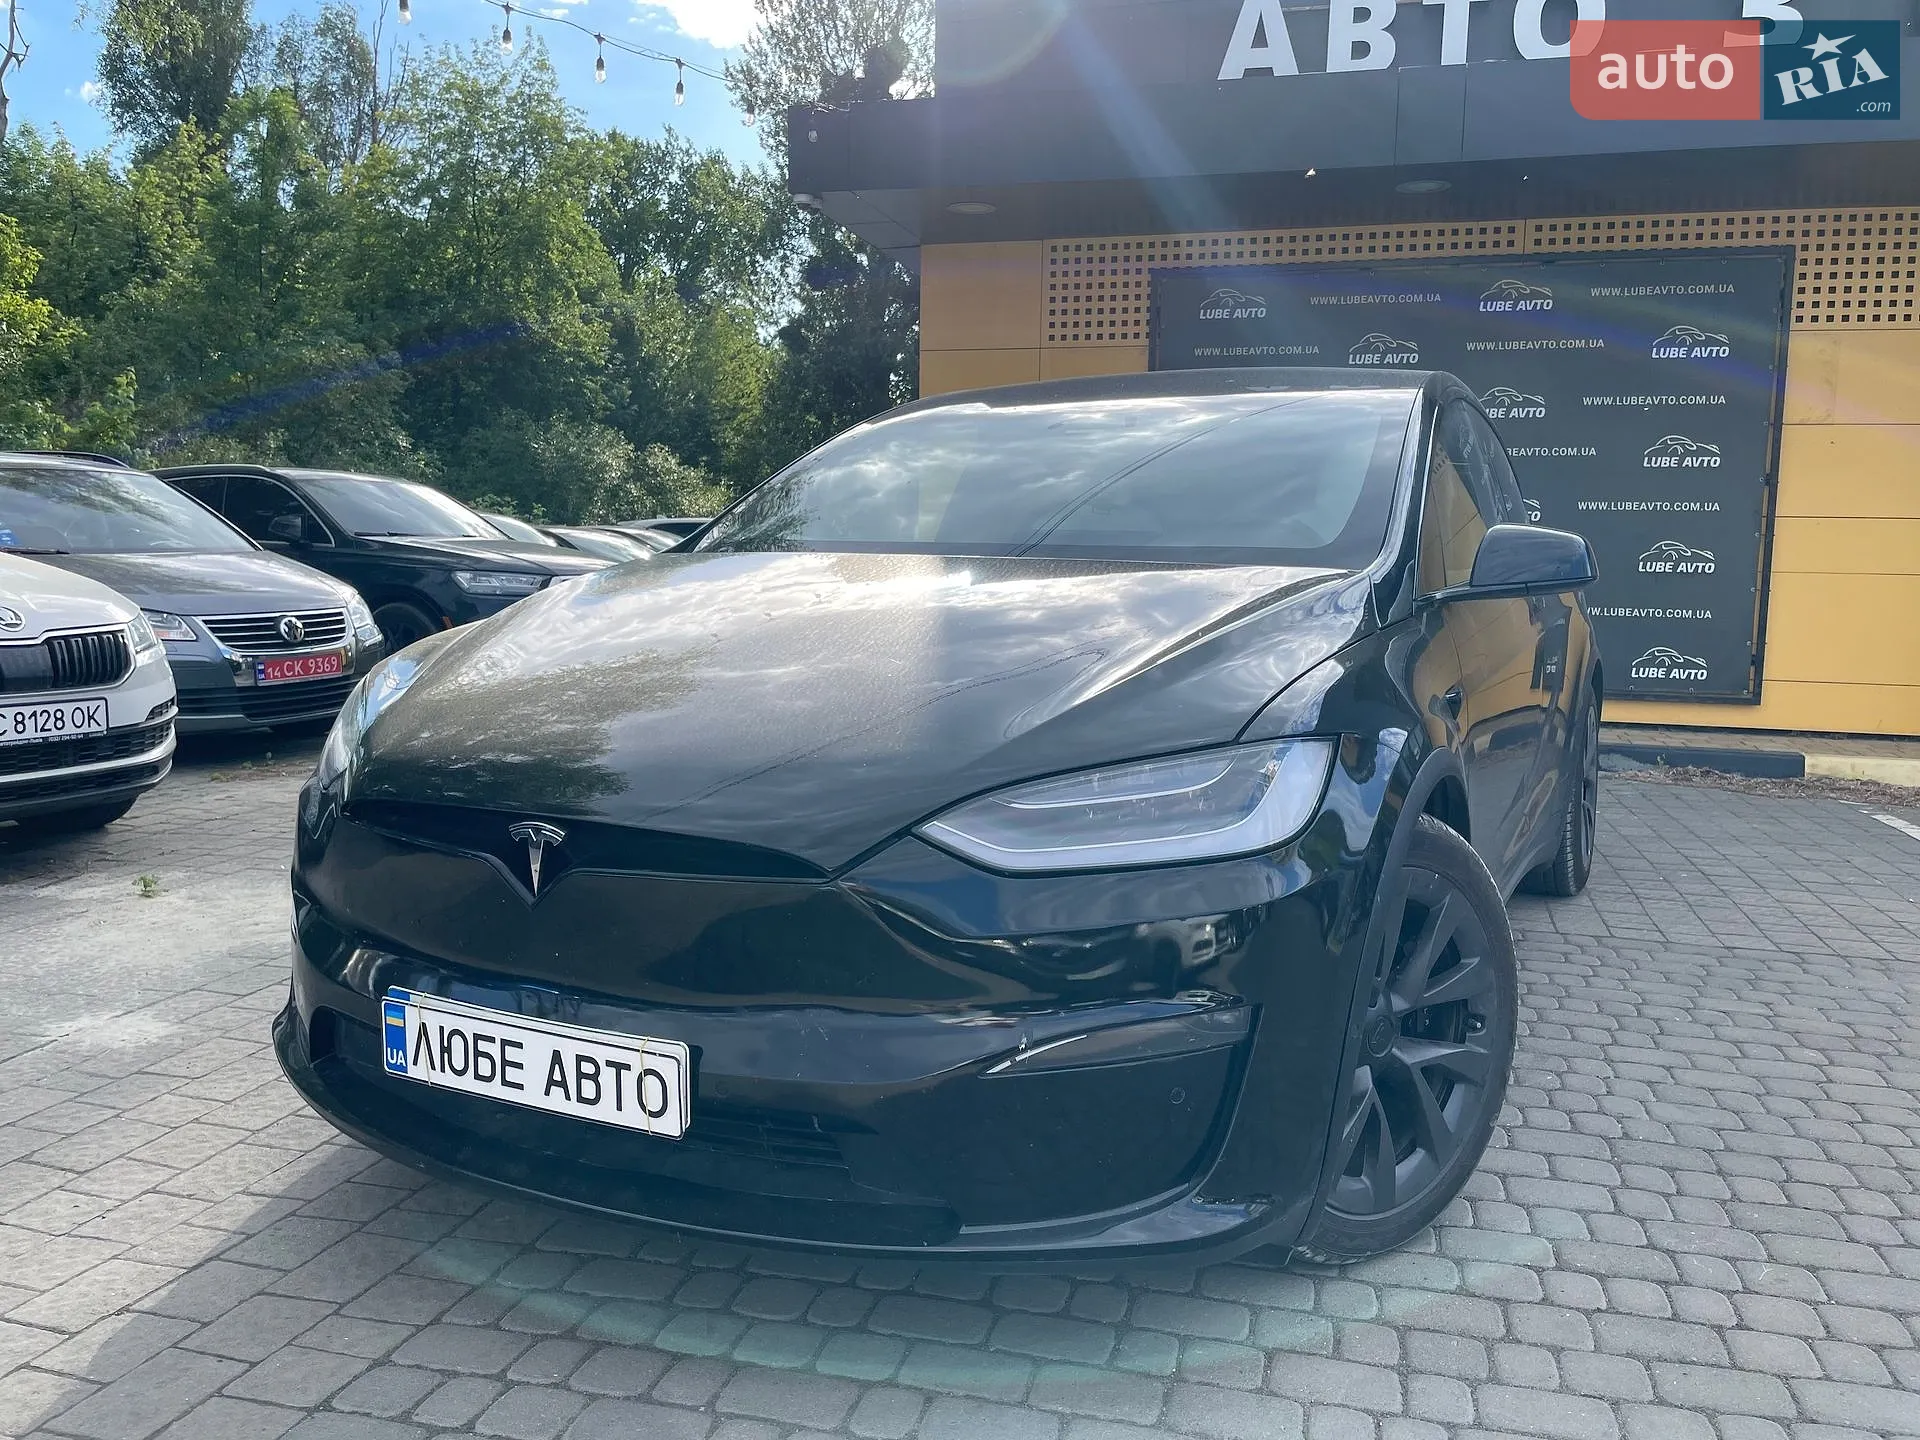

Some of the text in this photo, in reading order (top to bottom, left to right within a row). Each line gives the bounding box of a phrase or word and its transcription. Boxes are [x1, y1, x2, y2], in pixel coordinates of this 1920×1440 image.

[1217, 0, 1606, 80] АВТО
[1590, 284, 1735, 297] WWW.LUBEAVTO.COM.UA
[1310, 293, 1441, 305] WWW.LUBEAVTO.COM.UA
[1479, 299, 1553, 312] LUBE AVTO
[1199, 307, 1266, 319] LUBE AVTO
[1194, 345, 1320, 356] WWW.LUBEAVTO.COM.UA
[1466, 339, 1605, 351] WWW.LUBEAVTO.COM.UA
[1349, 352, 1419, 365] LUBE AVTO
[1652, 346, 1729, 359] LUBE AVTO
[1582, 395, 1726, 406] WWW.LUBEAVTO.COM.UA
[1509, 407, 1546, 418] AVTO
[1643, 456, 1720, 468] LUBE AVTO
[1577, 501, 1720, 512] WWW.LUBEAVTO.COM.UA
[1638, 561, 1715, 574] LUBE AVTO
[267, 667, 280, 679] 14
[308, 656, 338, 674] 9369
[1631, 667, 1708, 681] LUBE AVTO
[13, 708, 65, 735] 8128
[71, 704, 102, 729] OK
[387, 1047, 407, 1068] UA
[413, 1021, 669, 1119] ЛЮБЕ АВТО
